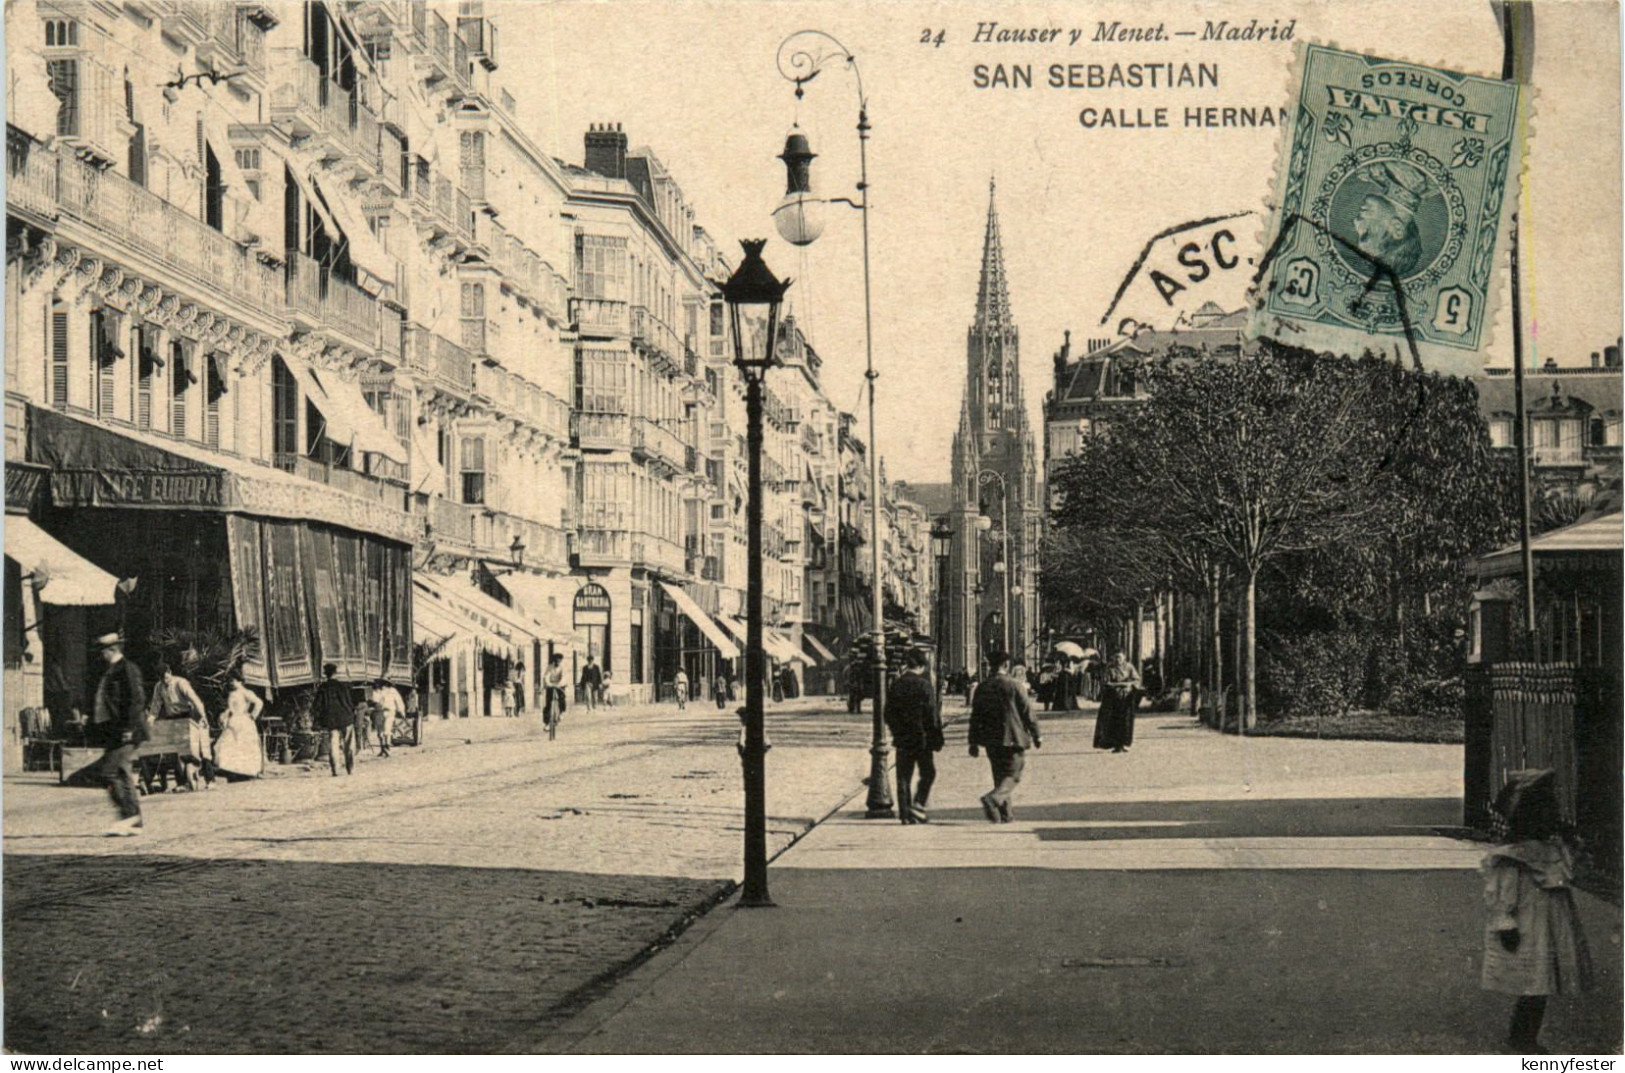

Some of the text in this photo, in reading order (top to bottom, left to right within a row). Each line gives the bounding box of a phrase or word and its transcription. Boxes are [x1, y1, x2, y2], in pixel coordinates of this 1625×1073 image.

[1361, 71, 1466, 107] CORREOS
[1326, 85, 1493, 134] ESPAÑA
[1445, 293, 1462, 325] 5
[150, 473, 220, 504] EUROPA
